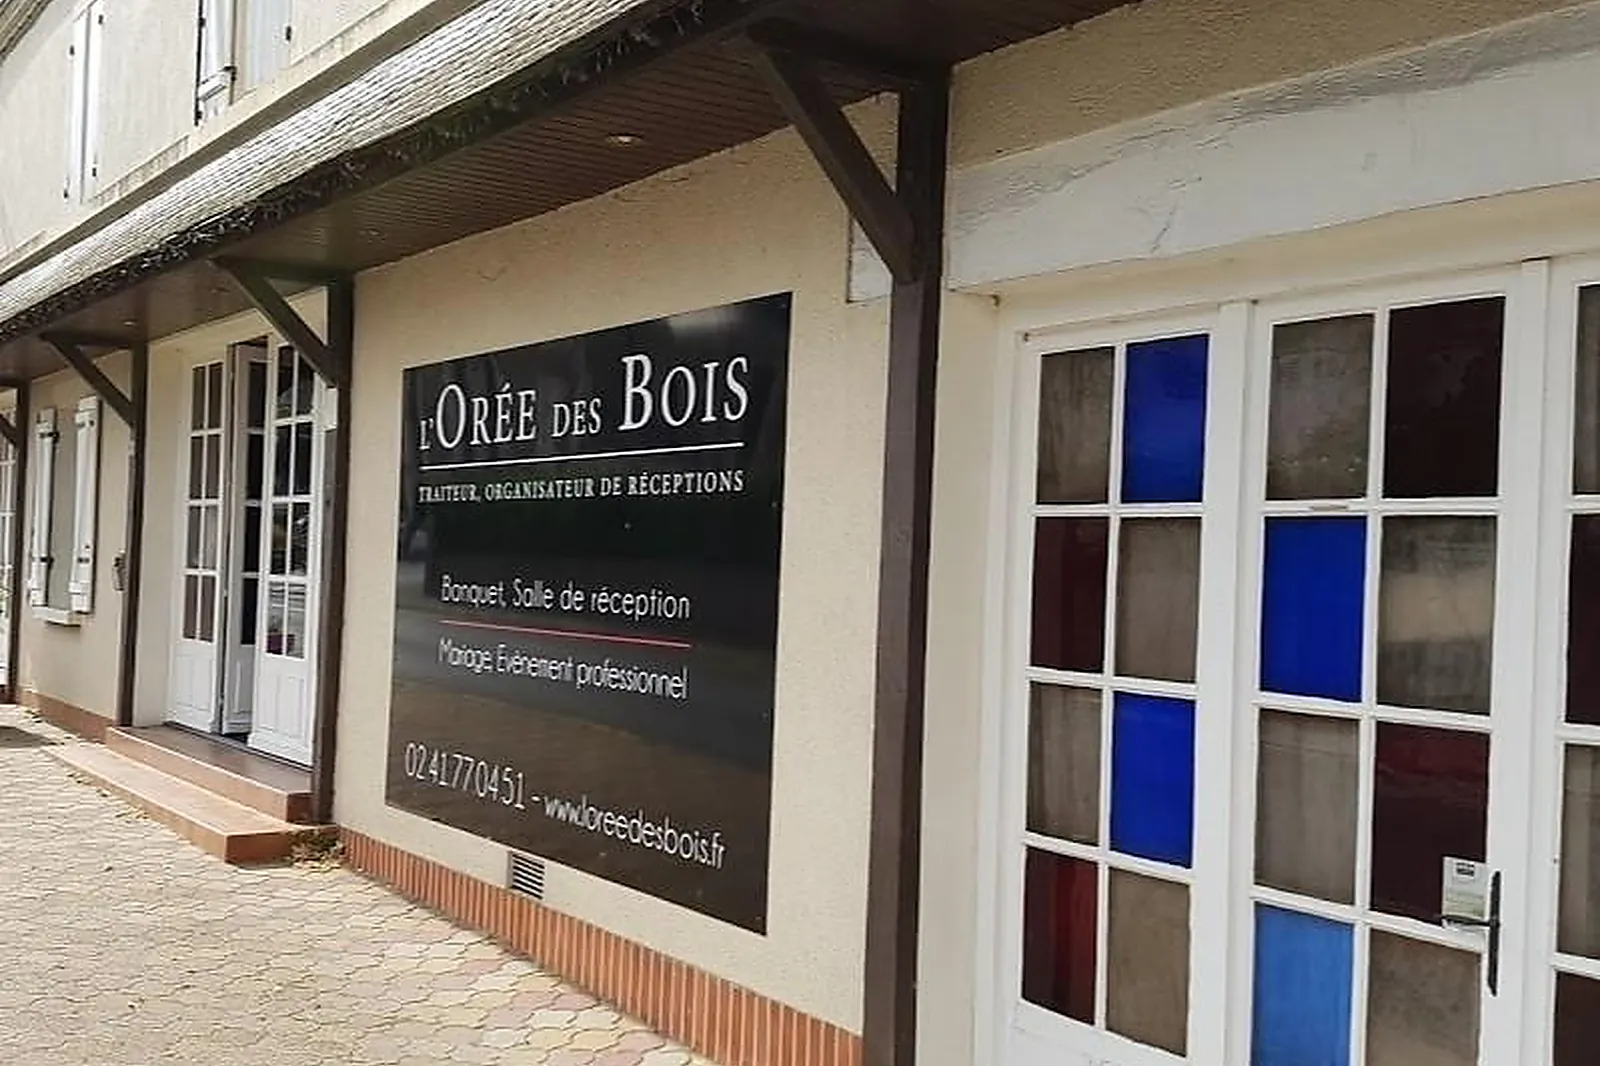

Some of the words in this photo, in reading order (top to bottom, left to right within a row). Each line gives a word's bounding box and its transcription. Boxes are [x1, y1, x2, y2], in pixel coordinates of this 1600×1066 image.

[551, 397, 602, 437] DES
[617, 353, 749, 431] BOIS
[484, 477, 596, 502] ORGANISATEUR
[600, 476, 623, 496] DE
[627, 469, 745, 495] RÉCEPTIONS
[512, 577, 555, 610] Salle
[560, 580, 585, 612] de
[590, 585, 691, 621] réception
[576, 657, 688, 699] professionnel
[544, 795, 725, 869] www.loreedesbois.fr
